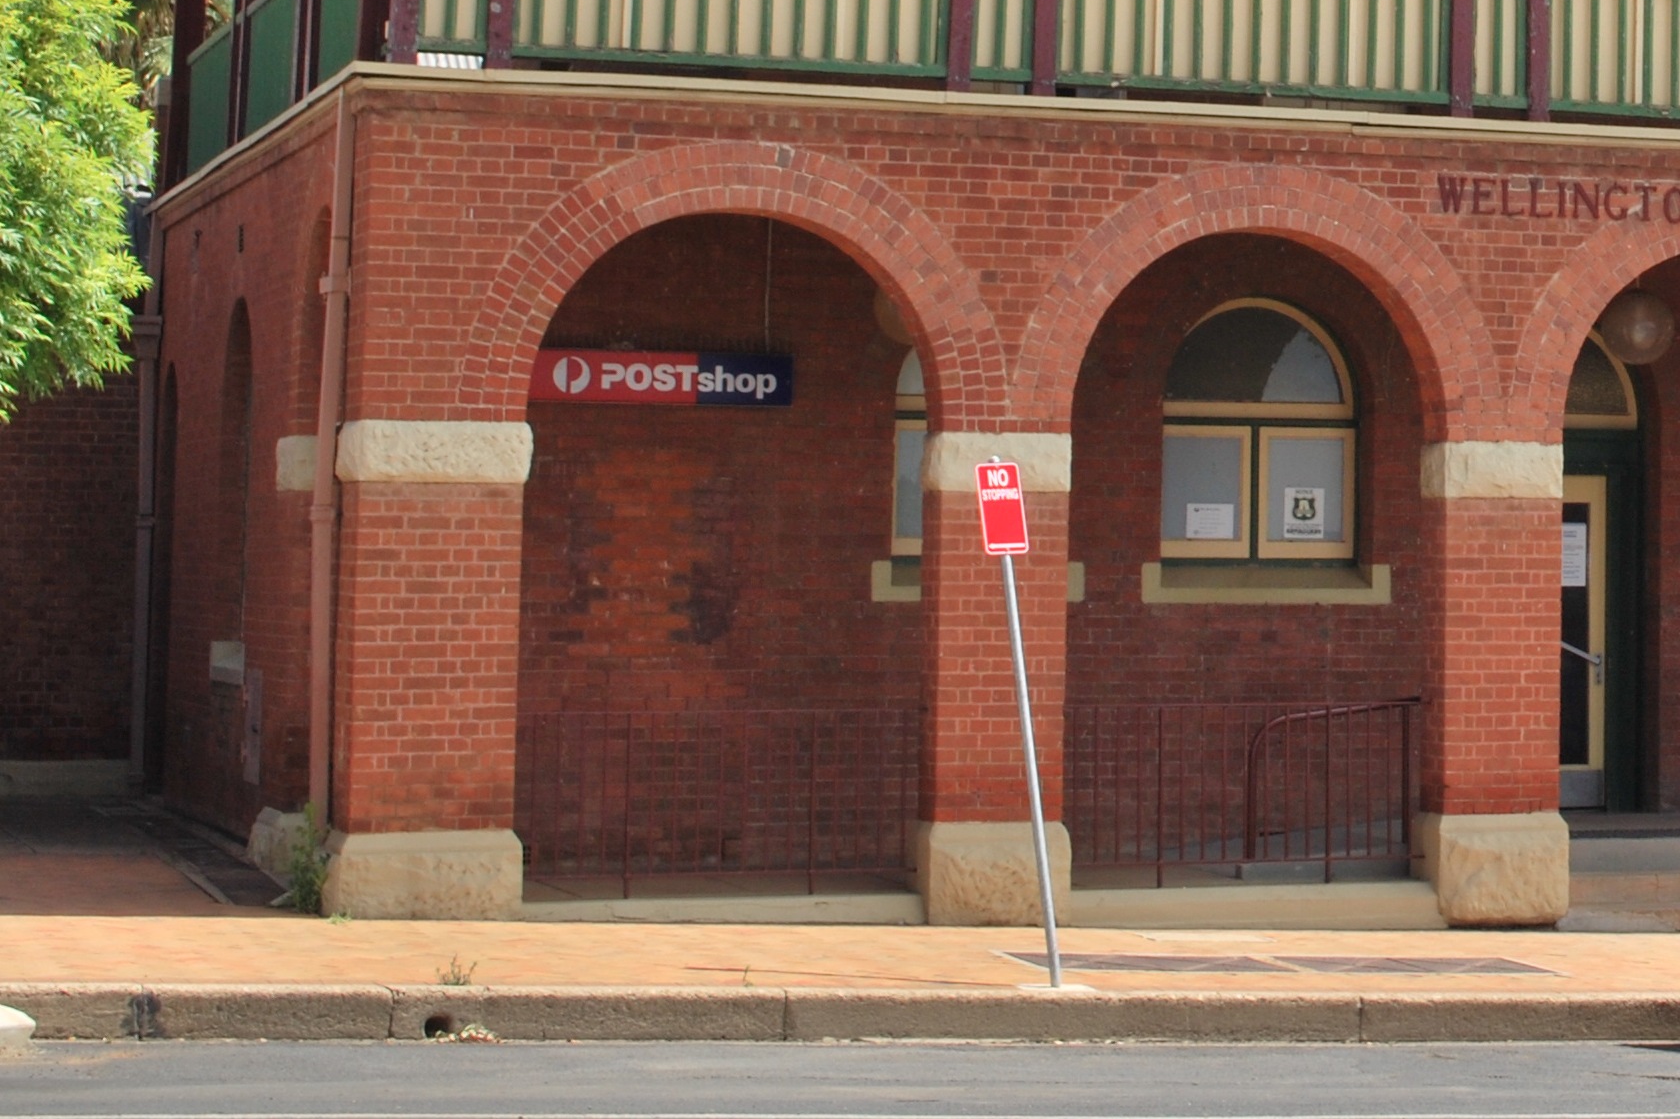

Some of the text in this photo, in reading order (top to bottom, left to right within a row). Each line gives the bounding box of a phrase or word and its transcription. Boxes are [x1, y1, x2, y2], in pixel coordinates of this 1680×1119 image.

[601, 362, 777, 400] POSTshop
[986, 468, 1009, 487] NO
[981, 487, 1020, 501] STOPPING
